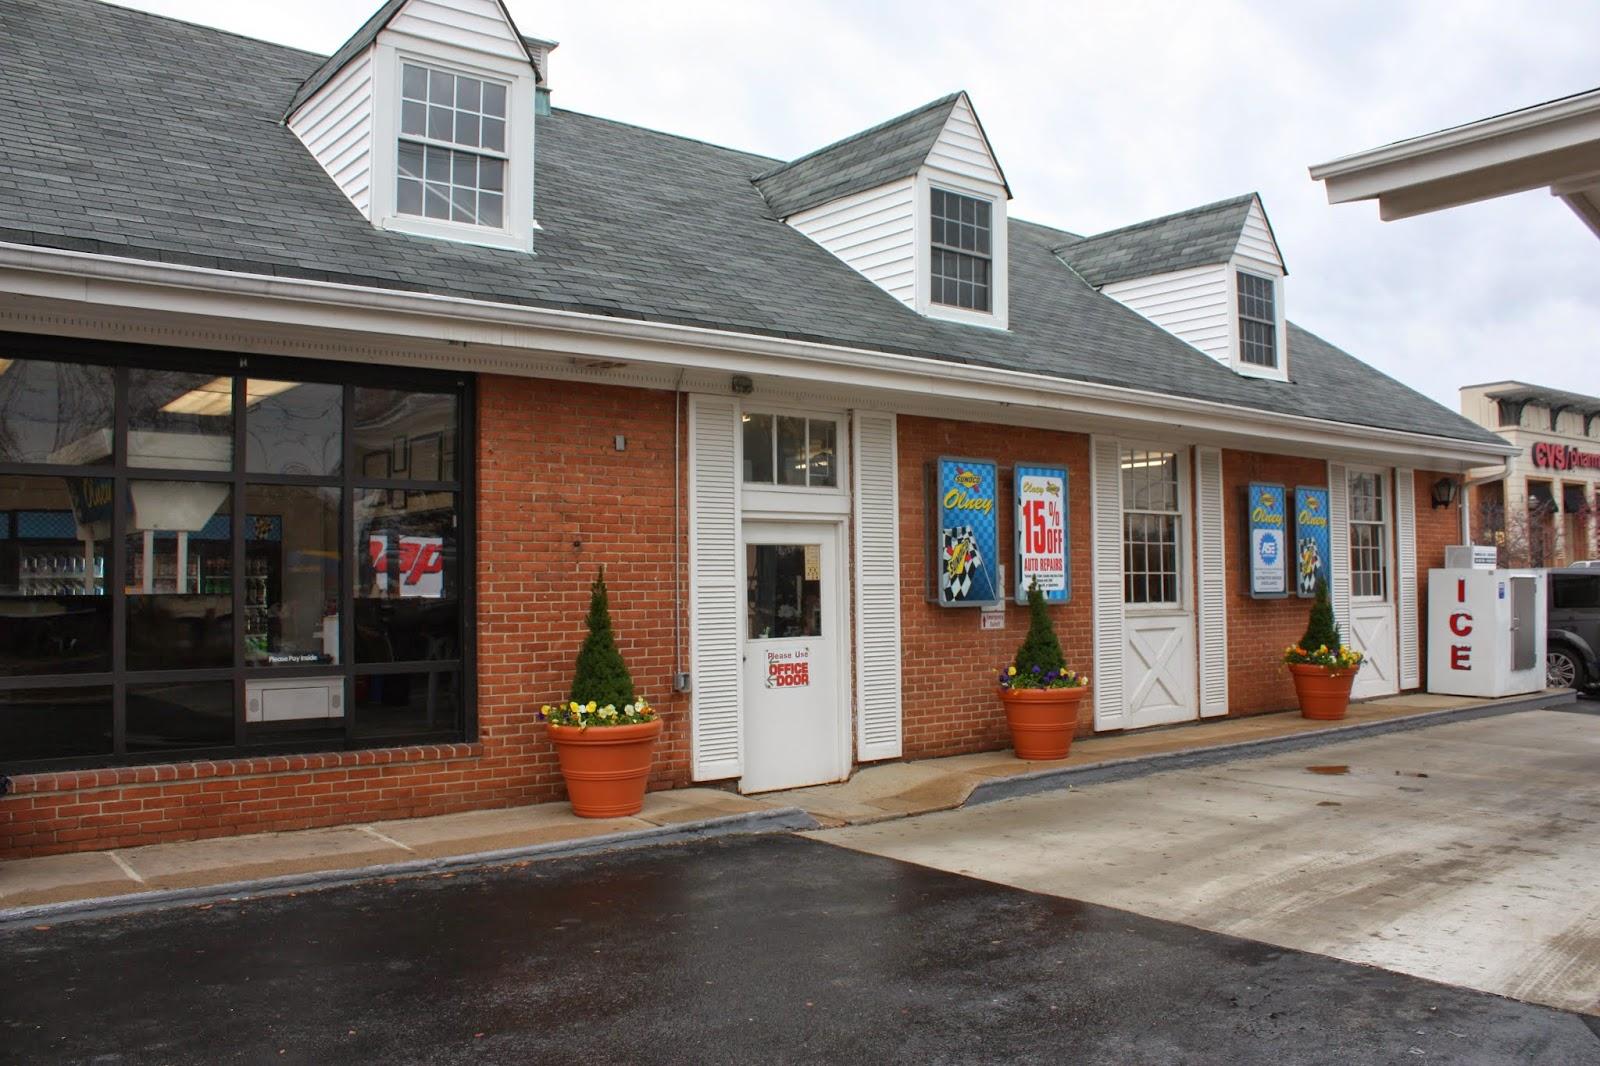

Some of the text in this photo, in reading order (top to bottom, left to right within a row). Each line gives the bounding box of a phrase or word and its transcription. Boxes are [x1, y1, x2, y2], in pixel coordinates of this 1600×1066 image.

[944, 488, 992, 516] Olney
[1047, 529, 1062, 553] OFF
[1024, 558, 1063, 572] AUTO REPAIRS
[1449, 579, 1473, 670] ICE
[268, 655, 289, 663] Please
[795, 650, 809, 658] Use
[769, 662, 809, 675] OFFICE
[776, 674, 809, 687] DOOR
